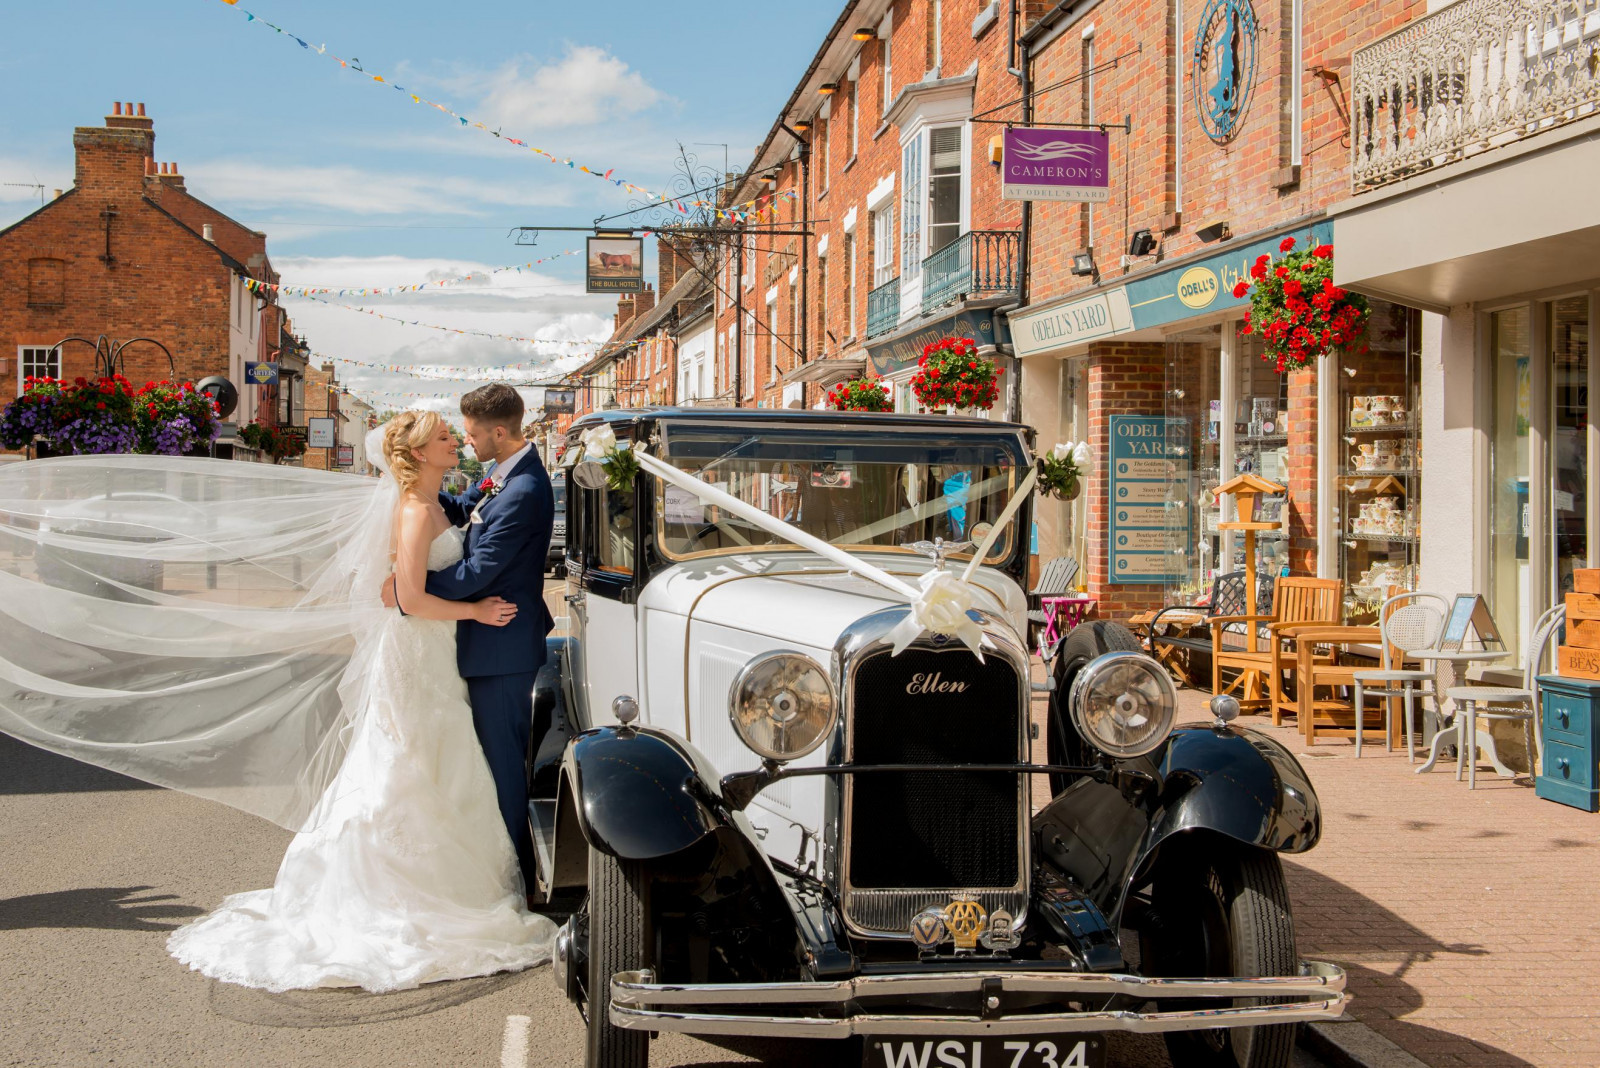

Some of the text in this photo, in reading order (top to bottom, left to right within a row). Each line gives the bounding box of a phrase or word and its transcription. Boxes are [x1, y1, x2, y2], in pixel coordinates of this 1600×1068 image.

[1011, 165, 1102, 179] CAMERON'S
[1026, 189, 1071, 197] ODELL'S
[1180, 277, 1215, 297] ODELL'S
[980, 322, 991, 331] 60
[1032, 303, 1106, 343] ODELL'S YARD
[248, 368, 277, 377] CARTERS
[906, 671, 971, 695] Ellen
[1003, 1040, 1089, 1068] 734
